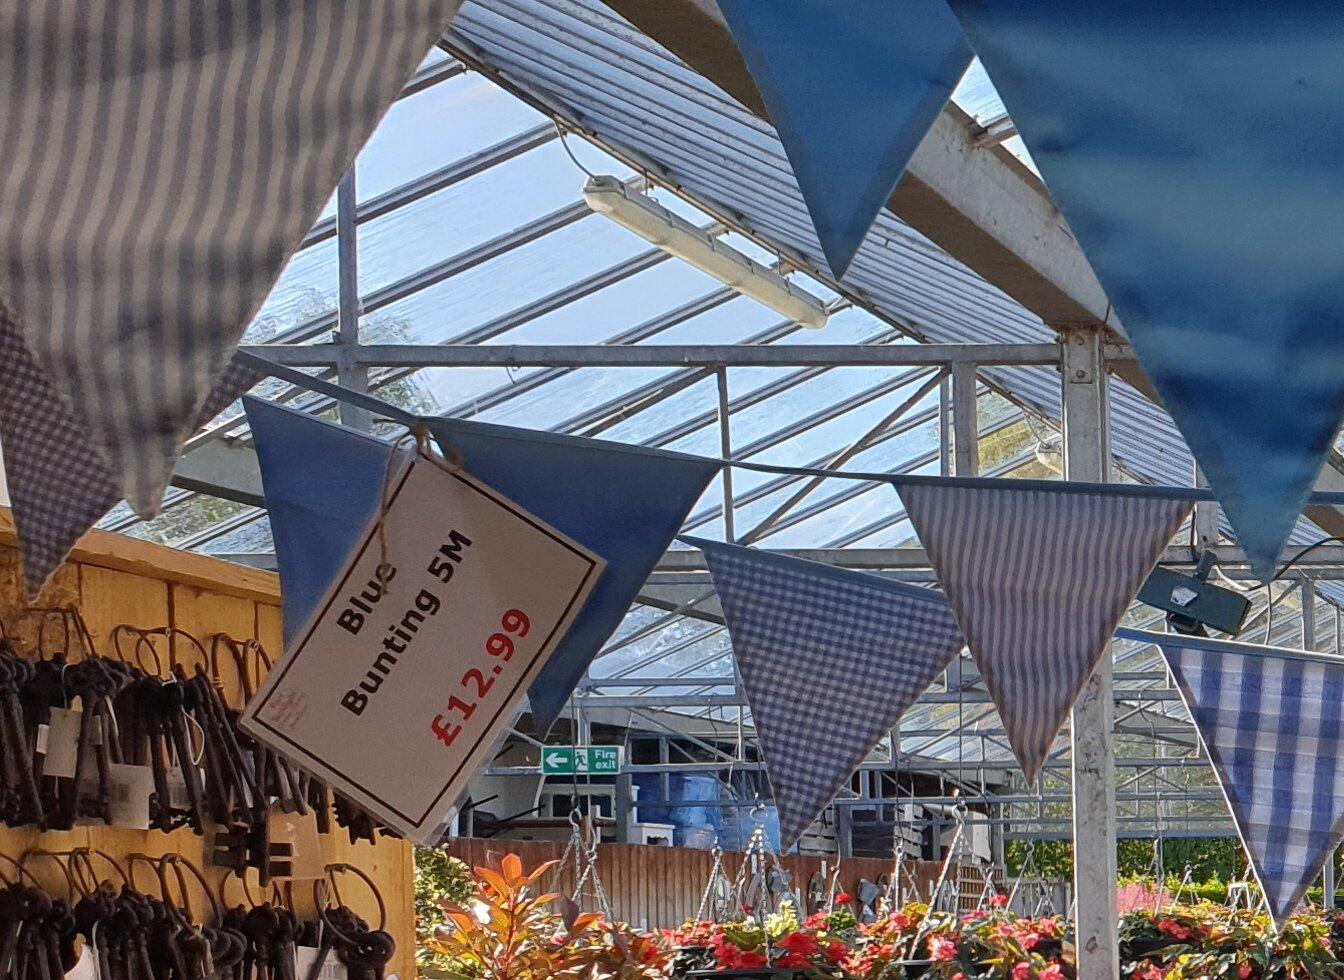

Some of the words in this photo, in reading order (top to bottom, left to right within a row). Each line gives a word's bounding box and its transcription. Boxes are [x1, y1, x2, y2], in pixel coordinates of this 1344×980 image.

[336, 562, 397, 637] Blue
[340, 587, 442, 717] Bunting
[427, 529, 473, 584] 5M
[431, 607, 532, 748] £12.99
[594, 749, 617, 759] Fire
[595, 759, 617, 770] exit
